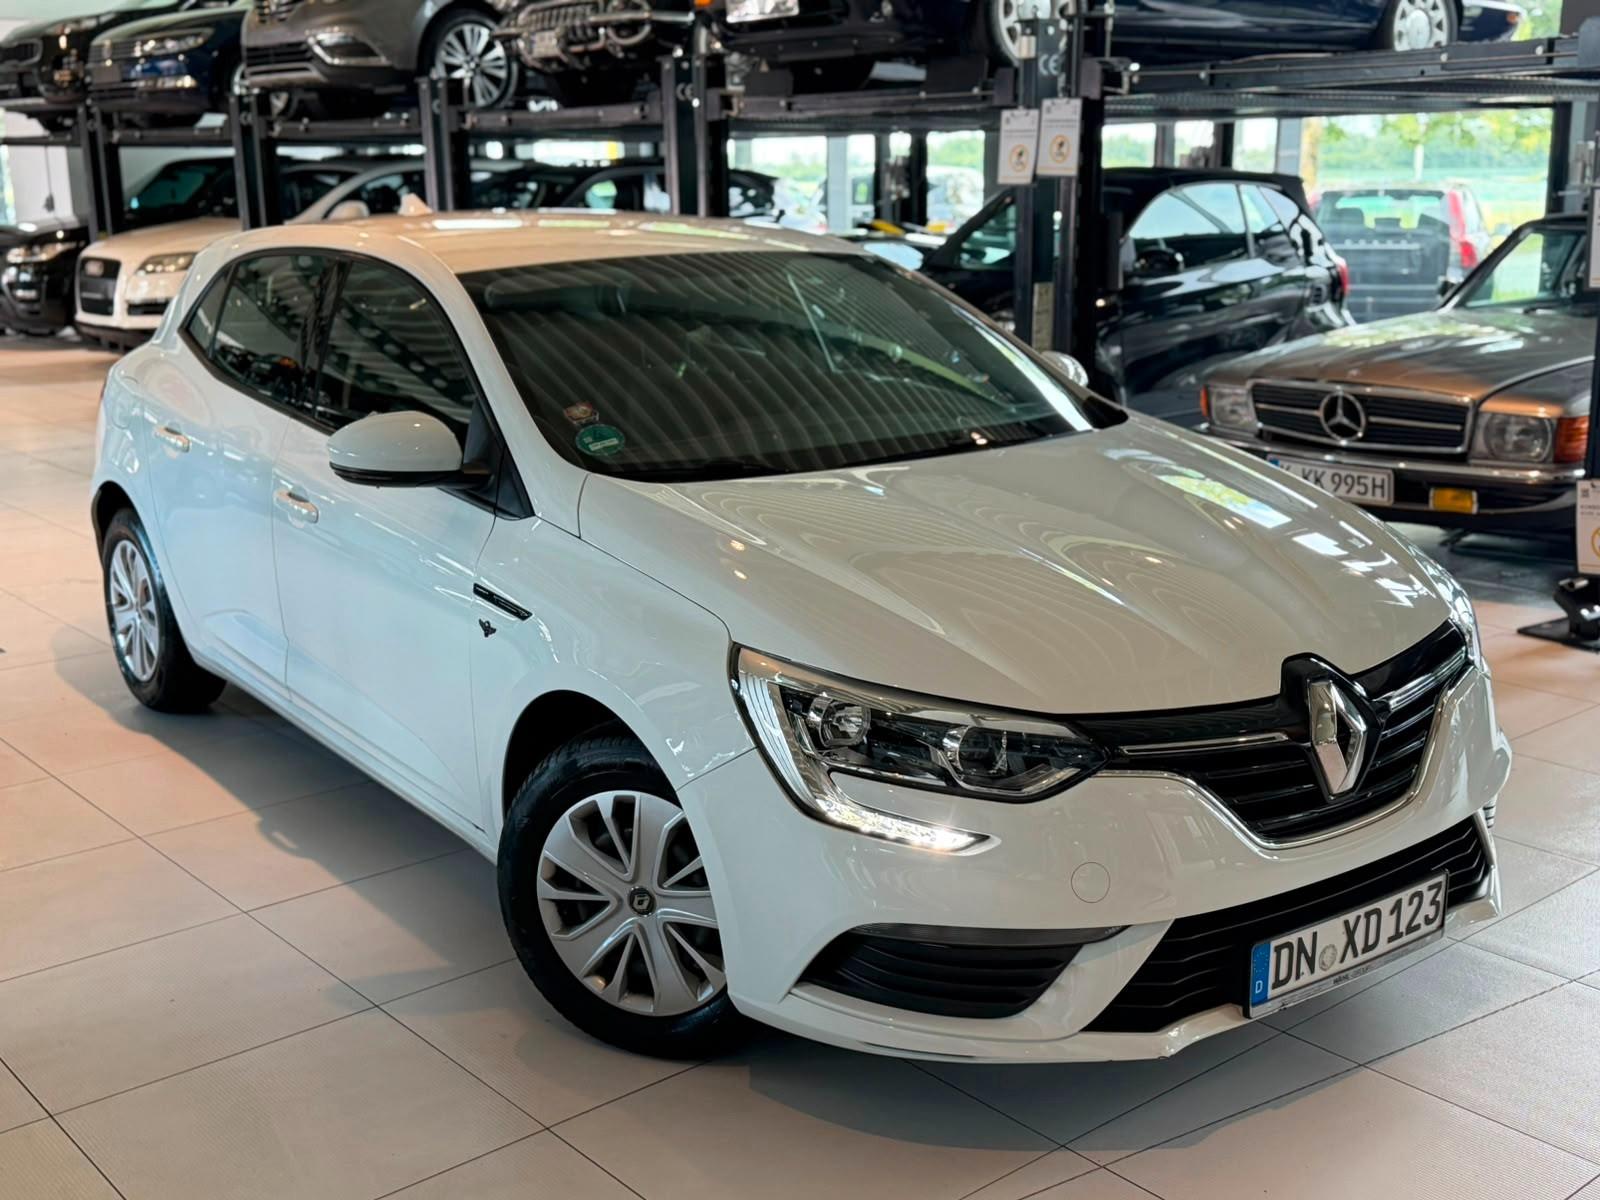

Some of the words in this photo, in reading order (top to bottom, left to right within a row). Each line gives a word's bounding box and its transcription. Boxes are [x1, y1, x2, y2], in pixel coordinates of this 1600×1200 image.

[1331, 472, 1386, 498] 995H
[1271, 931, 1318, 991] DN
[1387, 881, 1443, 944] 123
